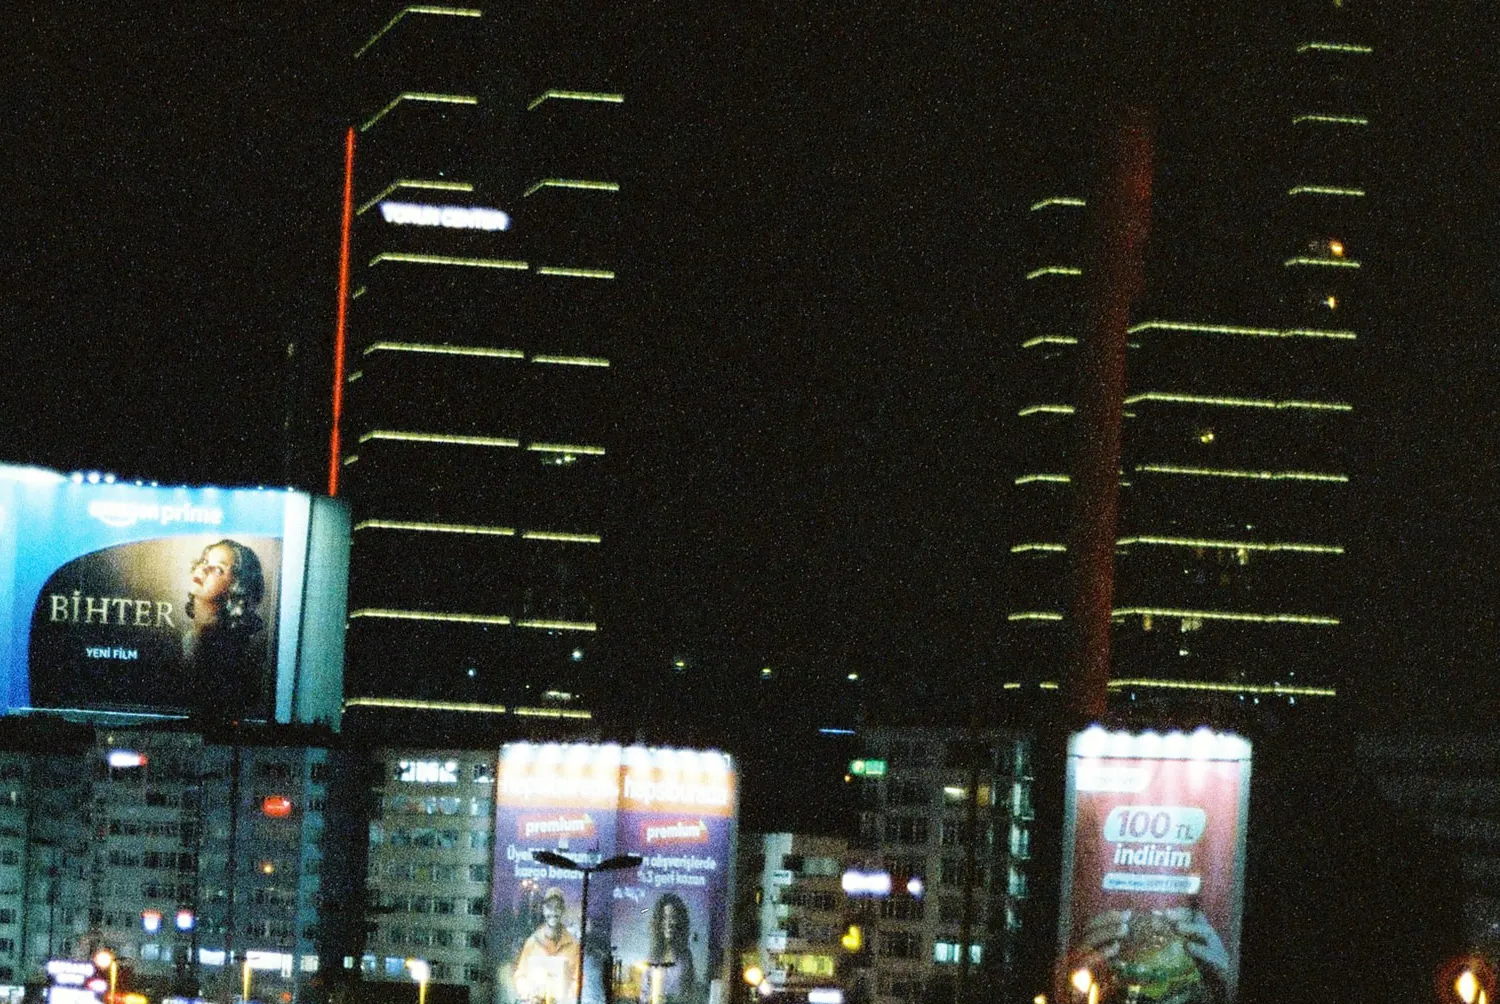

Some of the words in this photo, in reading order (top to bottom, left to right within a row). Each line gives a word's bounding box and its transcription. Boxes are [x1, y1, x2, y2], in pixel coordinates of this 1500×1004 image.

[50, 589, 174, 629] BİHTER
[85, 646, 110, 659] YENİ
[113, 647, 138, 661] FİLM
[1116, 809, 1171, 839] 100
[1175, 824, 1194, 840] TL
[1112, 843, 1192, 868] indirim
